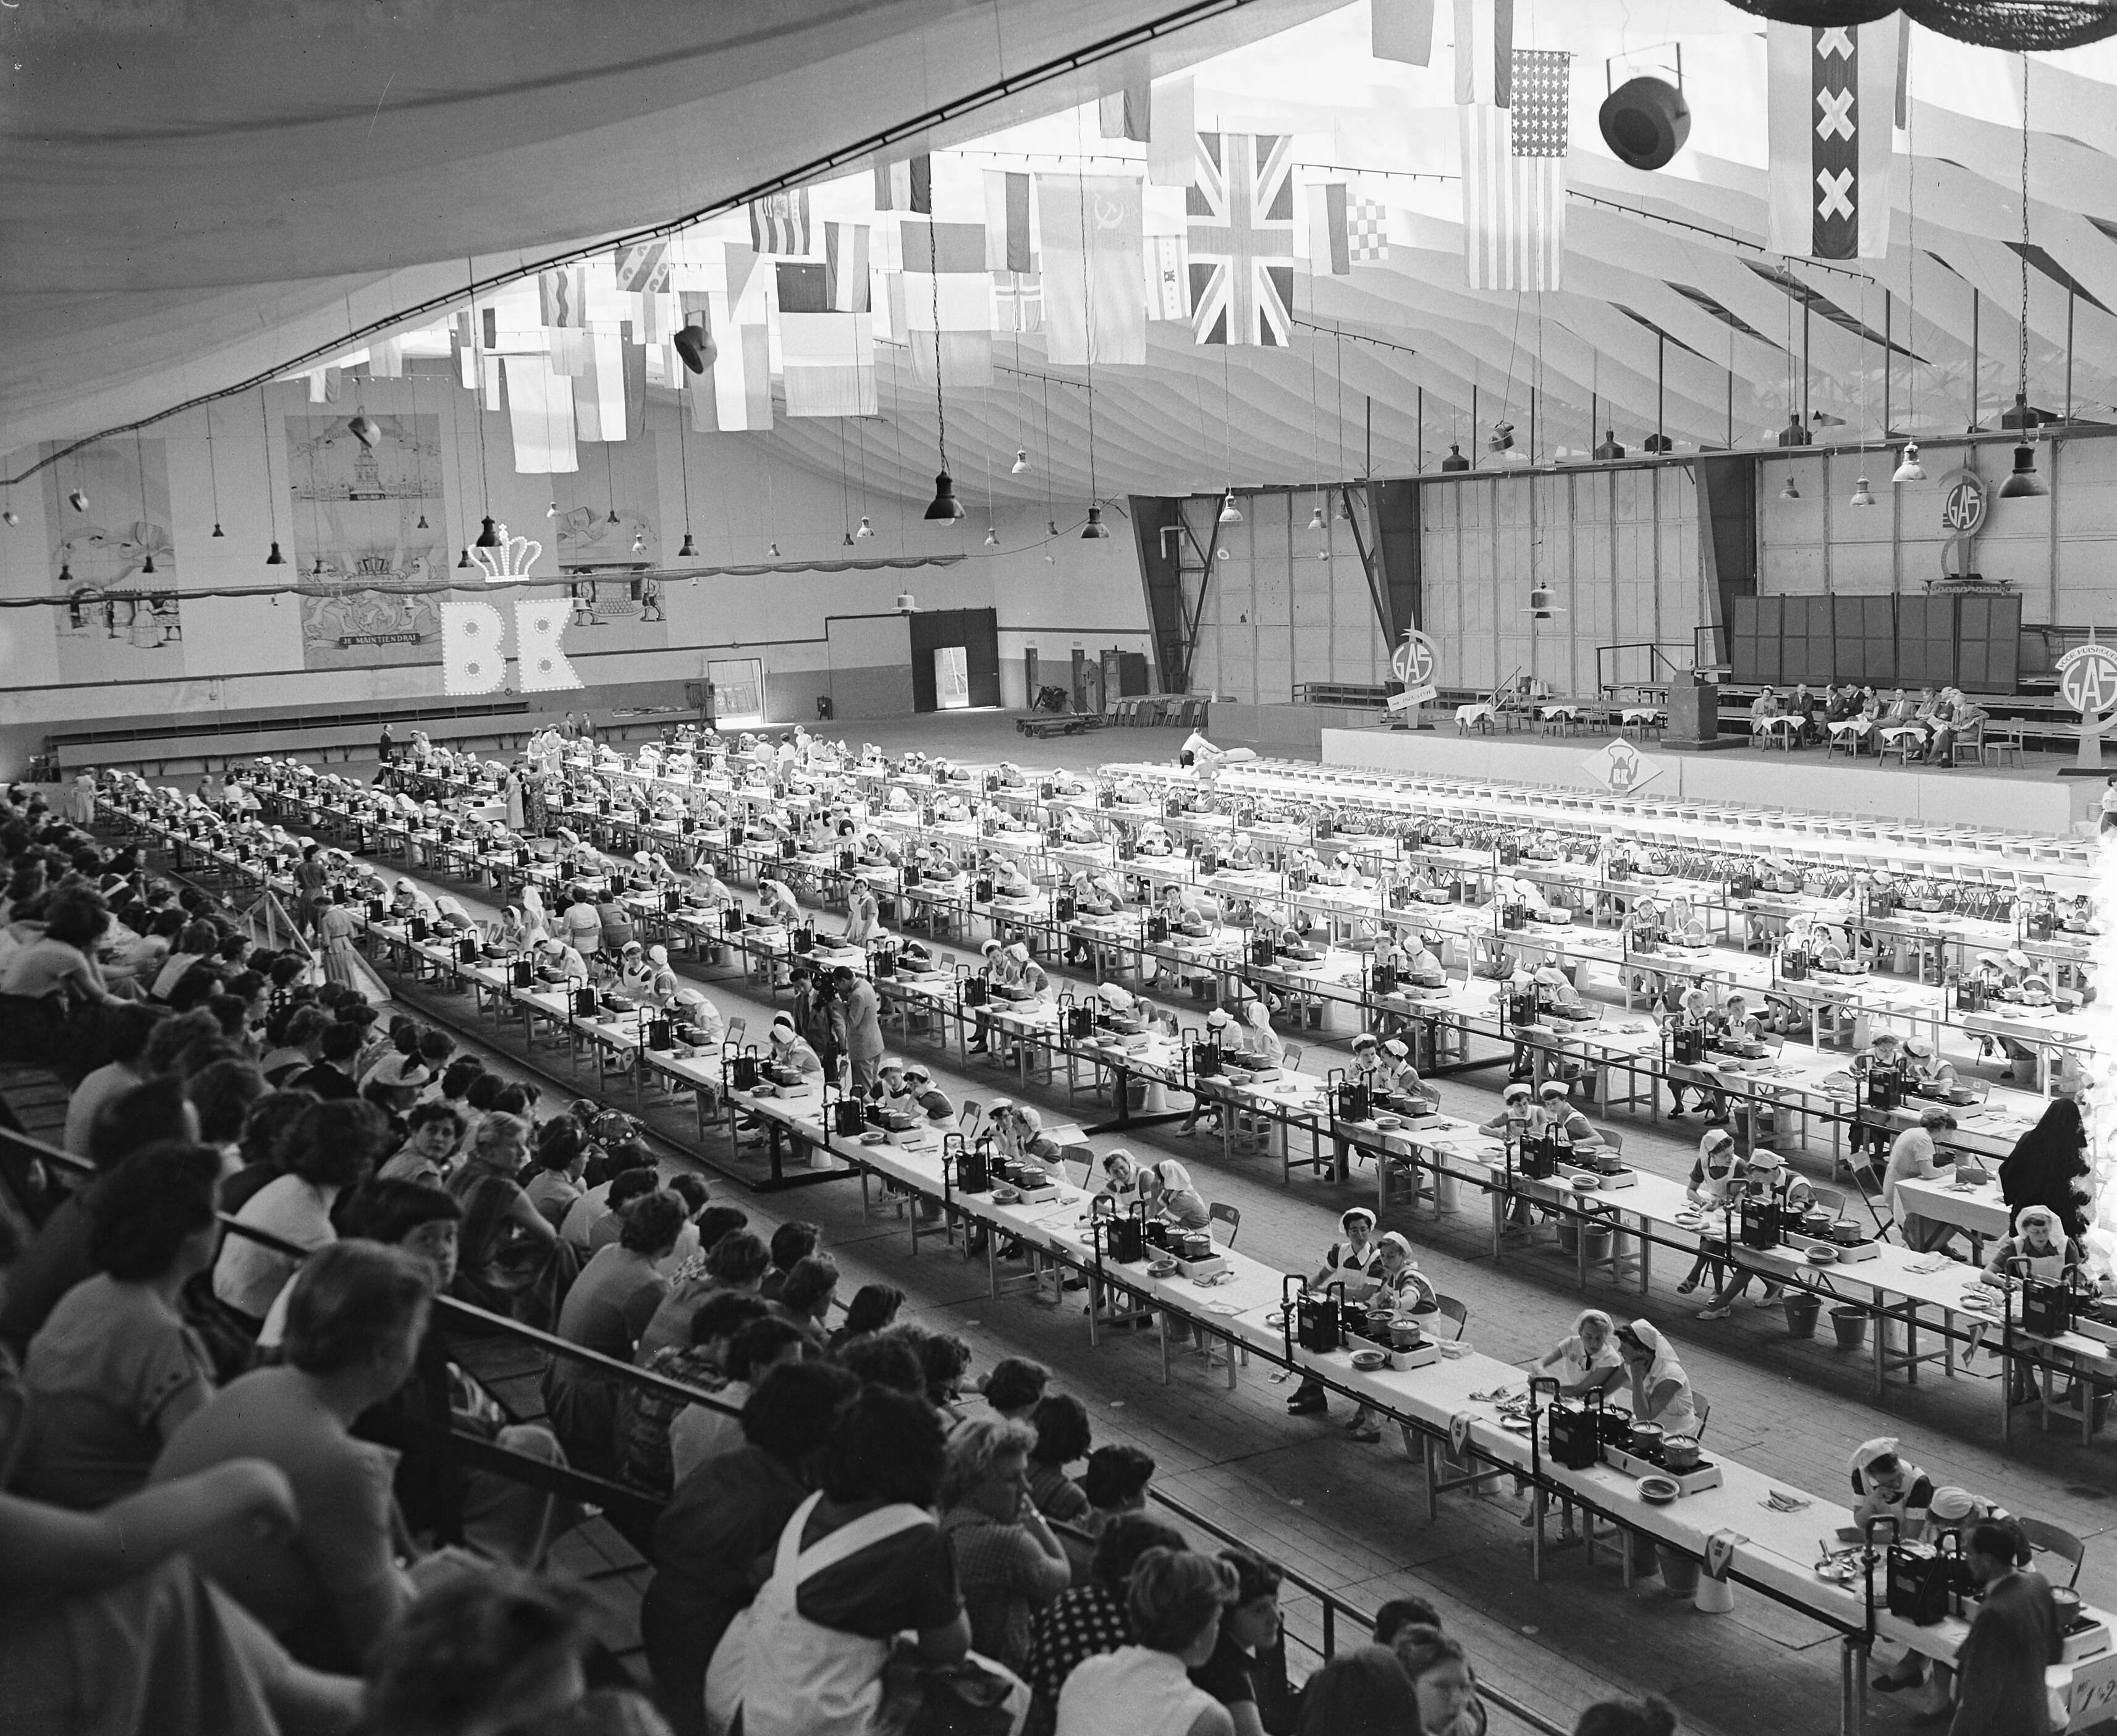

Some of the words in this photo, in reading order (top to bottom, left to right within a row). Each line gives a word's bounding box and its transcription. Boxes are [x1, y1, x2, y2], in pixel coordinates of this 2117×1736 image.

[1948, 485, 1980, 529] GAS
[356, 634, 416, 643] MAINTIENDRAI
[440, 597, 585, 696] BK
[1392, 643, 1432, 684] GAS
[2058, 652, 2076, 668] VOOR
[2063, 657, 2117, 713] GAS
[1613, 768, 1629, 784] BK
